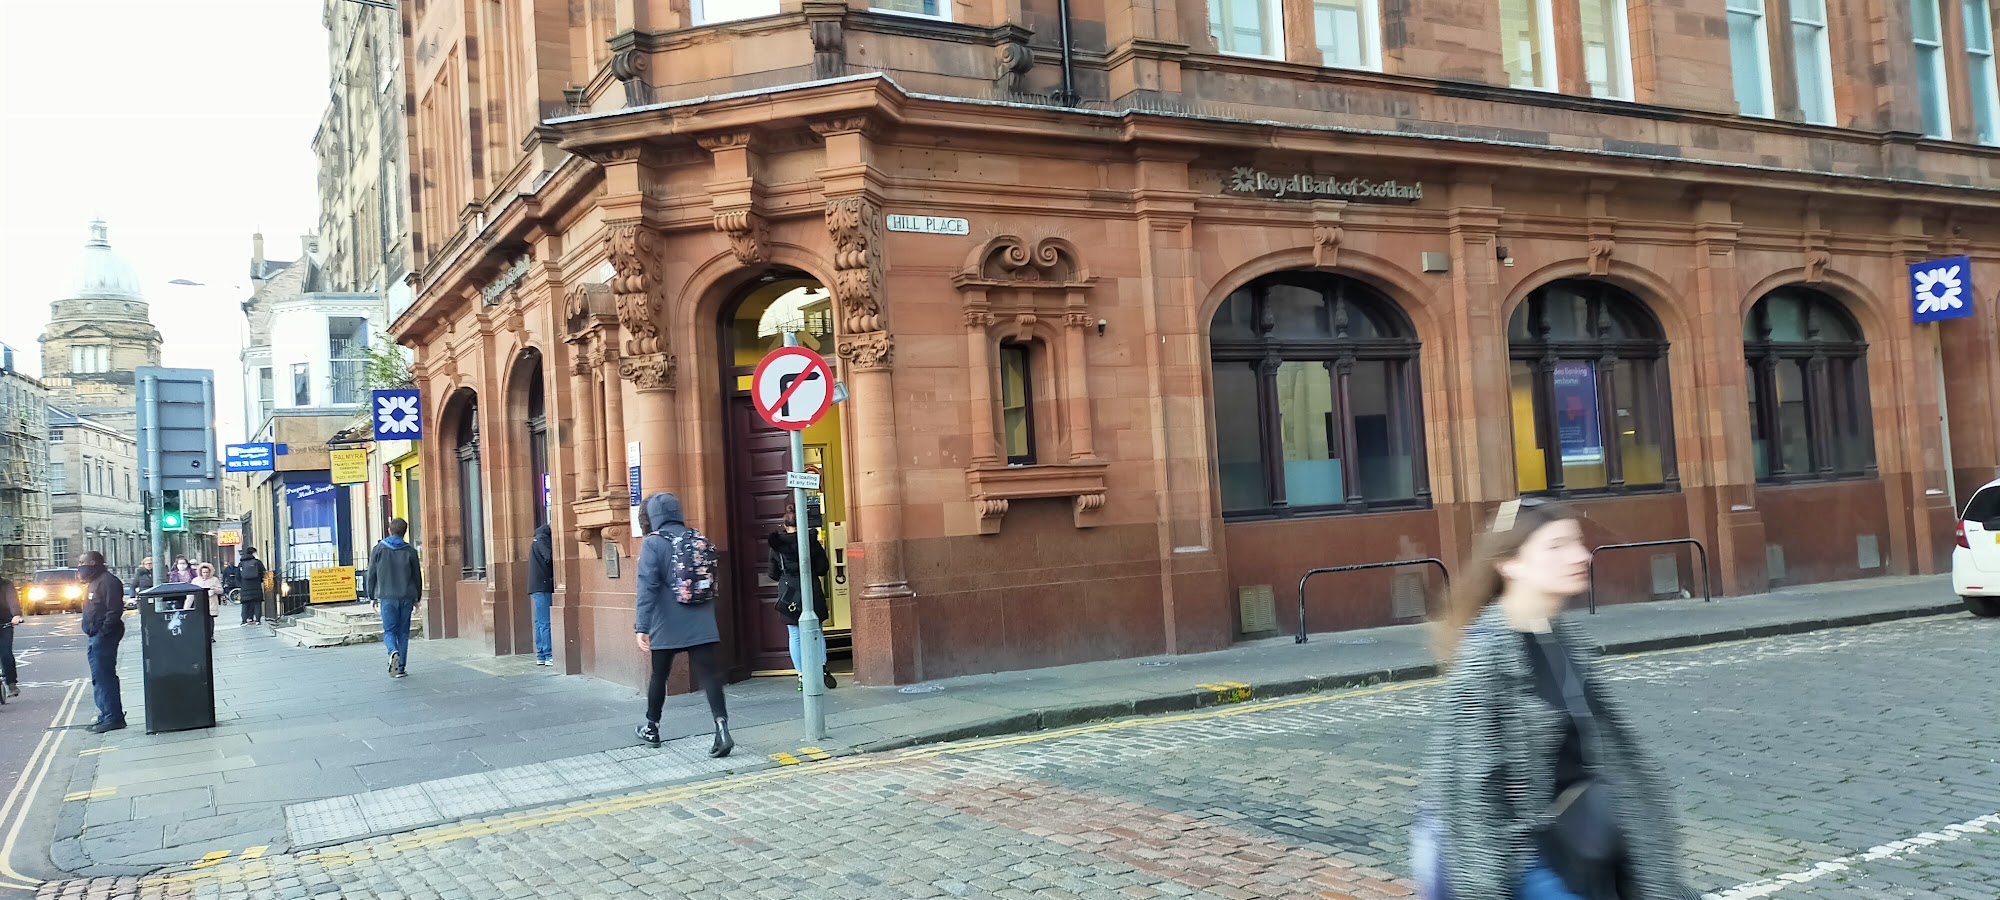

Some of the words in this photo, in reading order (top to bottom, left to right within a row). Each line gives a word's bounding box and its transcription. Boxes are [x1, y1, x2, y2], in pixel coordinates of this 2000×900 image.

[1257, 172, 1299, 197] Royal
[1302, 175, 1340, 194] Bank
[1341, 178, 1358, 195] of
[1360, 179, 1422, 199] Scotland
[893, 216, 920, 230] HILL
[926, 218, 964, 231] PLACE
[298, 490, 314, 499] Made
